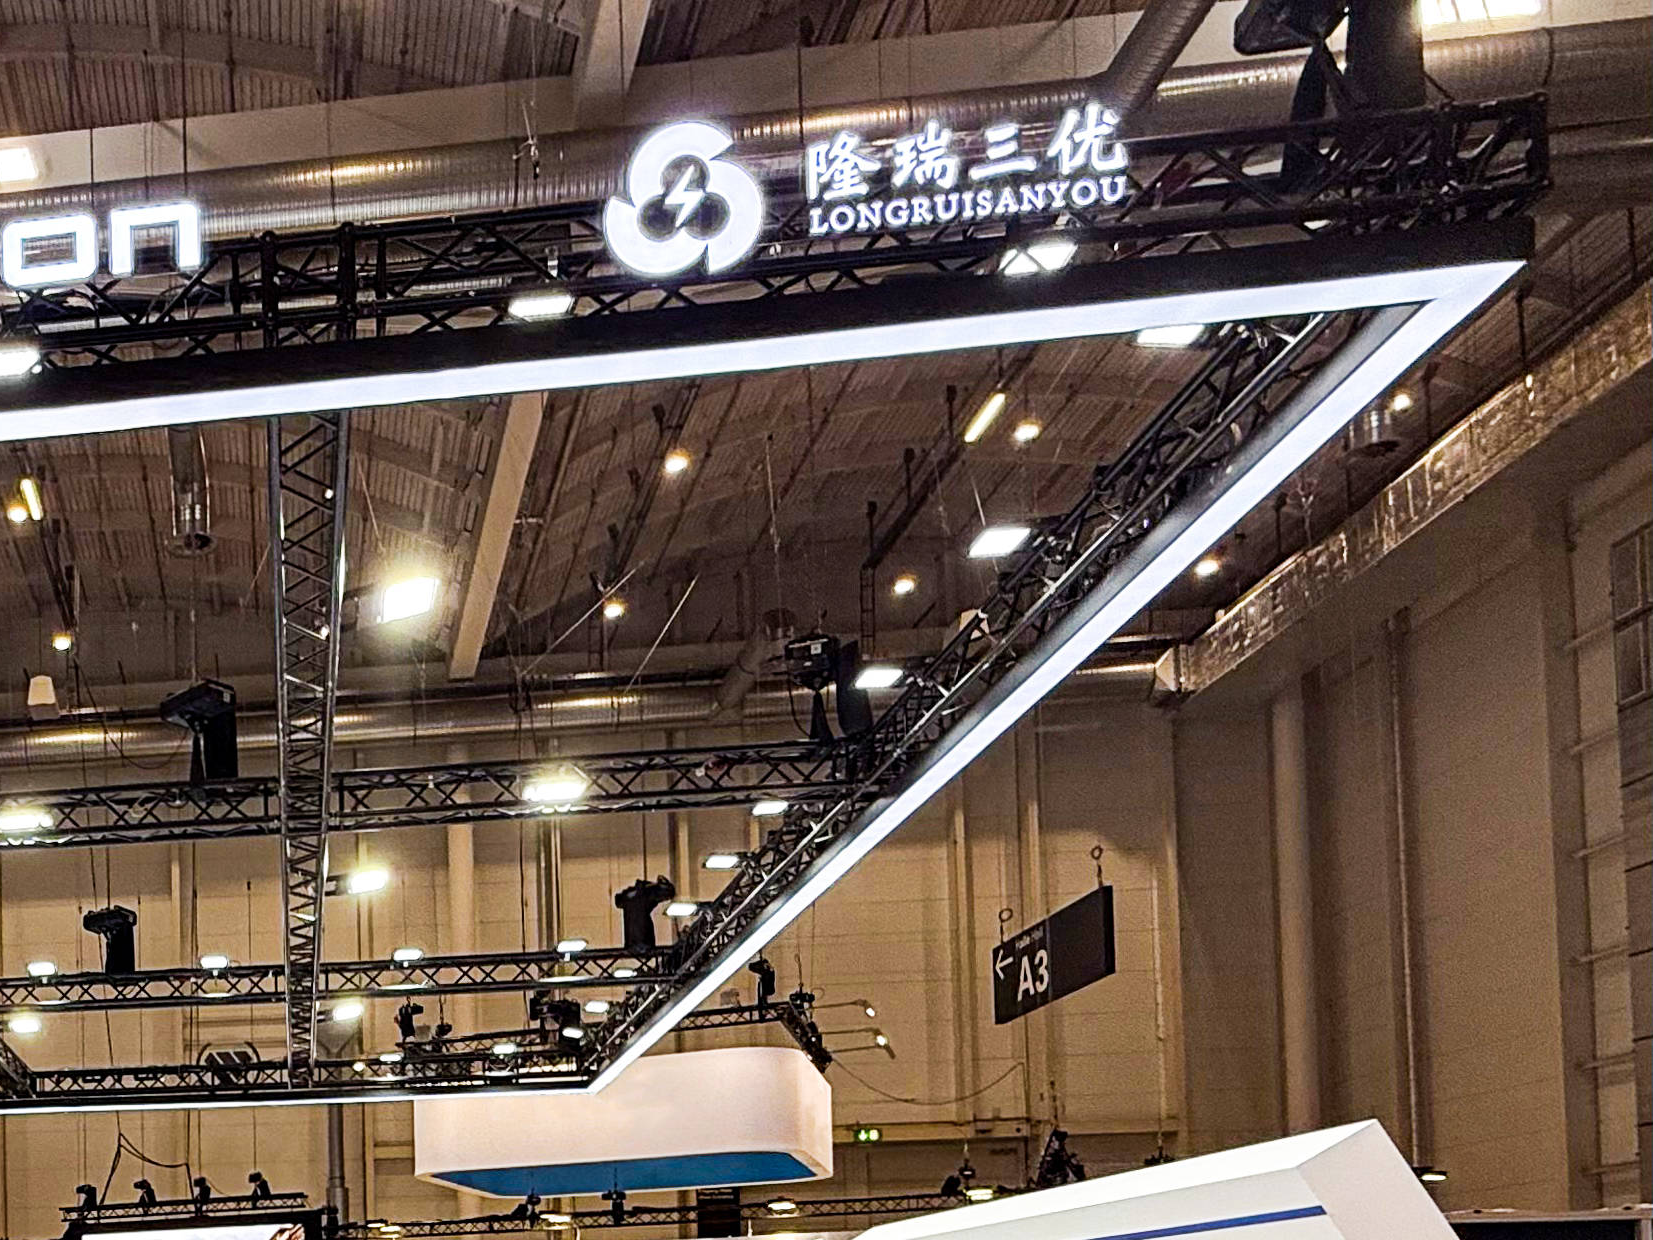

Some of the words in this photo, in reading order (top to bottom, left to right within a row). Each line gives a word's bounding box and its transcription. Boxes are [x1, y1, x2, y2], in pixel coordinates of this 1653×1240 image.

[806, 103, 1128, 201] 隆瑞三优
[809, 176, 1127, 235] LONGRUISANYOU
[1017, 949, 1049, 1002] A3
